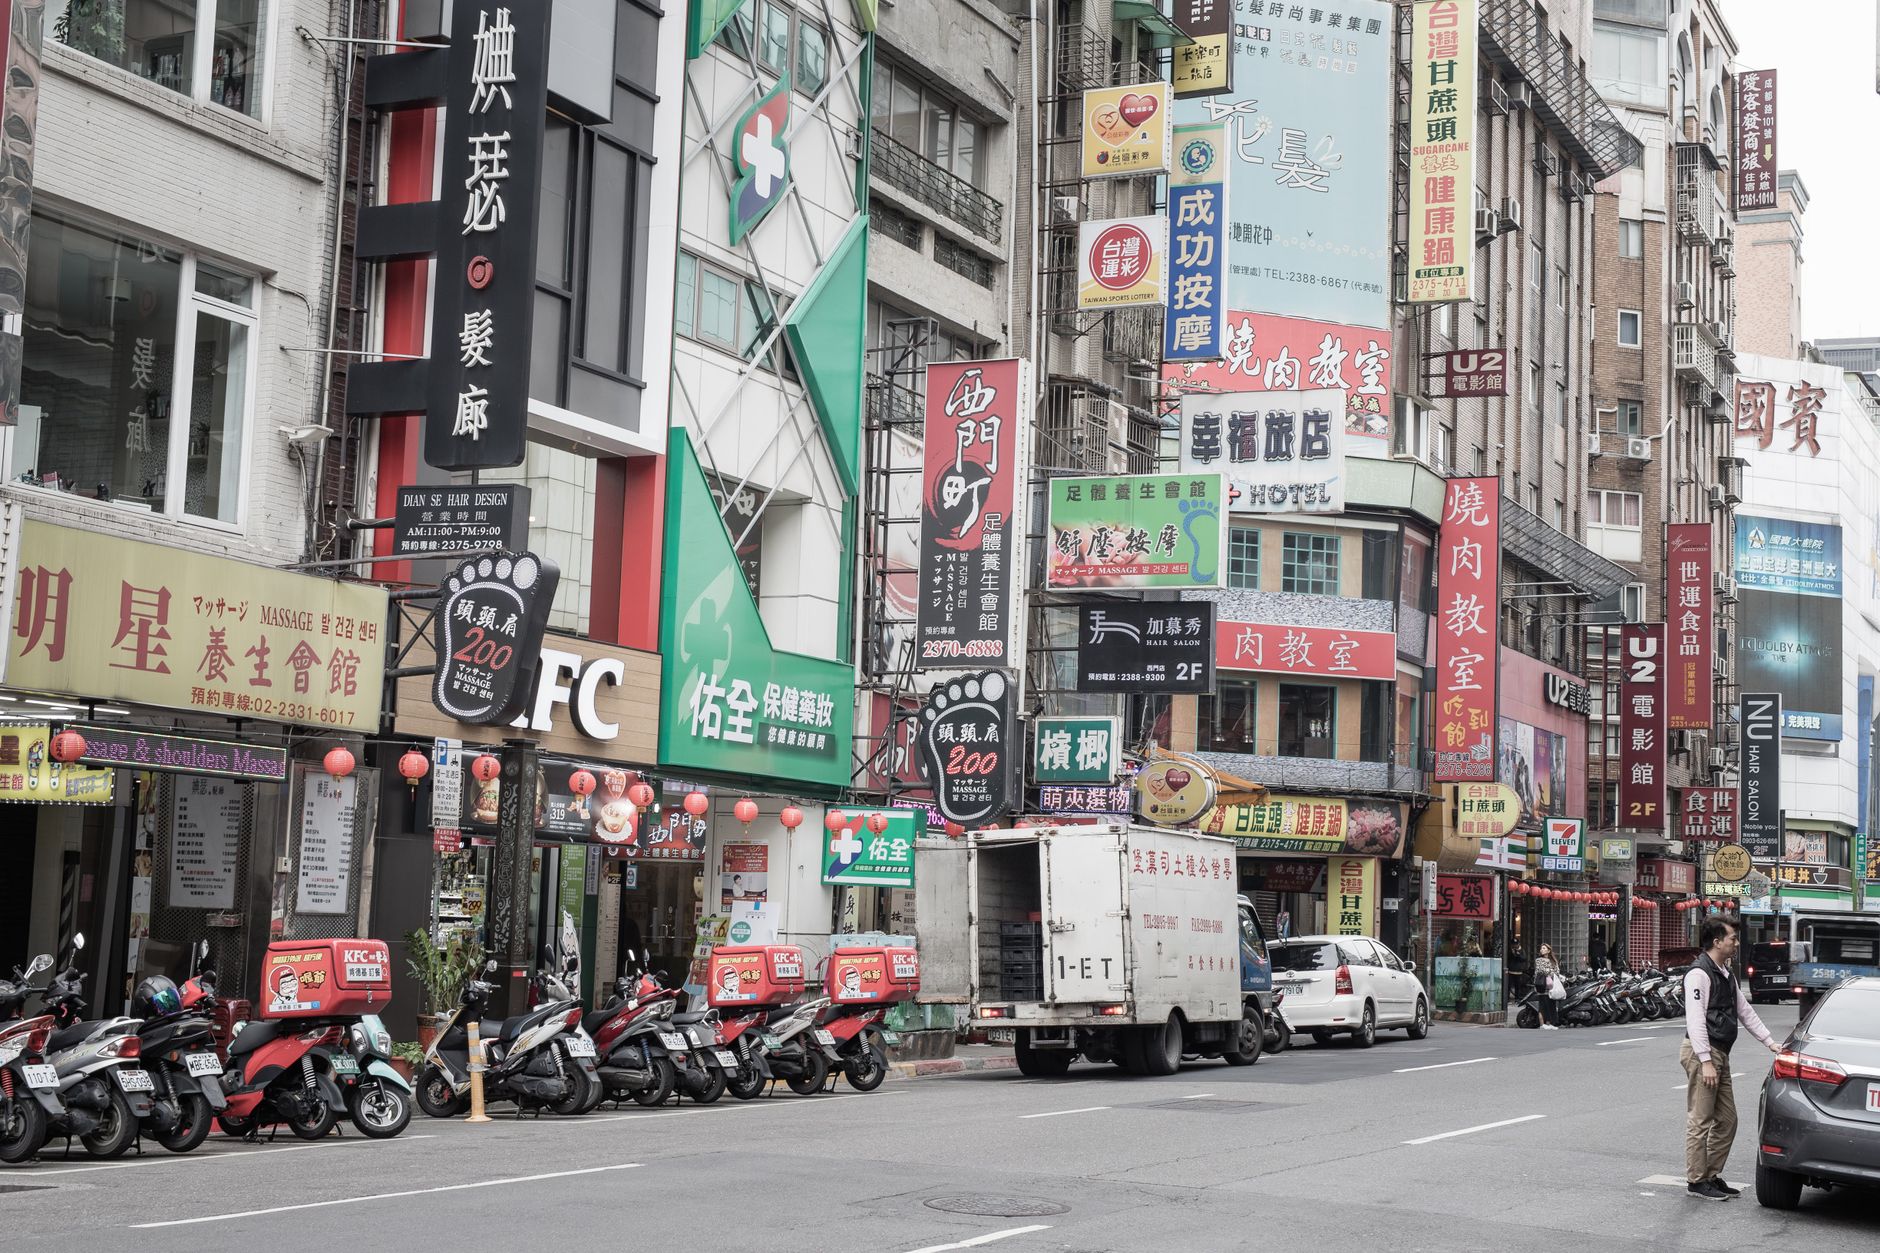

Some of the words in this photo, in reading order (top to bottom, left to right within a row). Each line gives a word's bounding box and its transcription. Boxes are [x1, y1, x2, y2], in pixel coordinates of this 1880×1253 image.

[1426, 59, 1459, 143] 甘蔗頭
[1413, 143, 1470, 156] SUGARCANE
[1423, 176, 1456, 267] 健康鍋
[1101, 237, 1140, 259] 台灣
[1100, 257, 1140, 279] 運彩
[1173, 189, 1215, 352] 成功按摩
[1264, 267, 1349, 289] TEL:2388-6867
[1412, 277, 1467, 290] 2375-4711
[1084, 295, 1108, 304] TAIWAN
[1109, 294, 1129, 302] SPORTS
[1130, 292, 1155, 301] LOTTERY
[1218, 317, 1390, 396] 燒肉教室
[1451, 353, 1503, 373] U2
[454, 308, 495, 438] 髮廊
[1451, 374, 1503, 391] 電影館
[1346, 394, 1381, 413] 餐廳
[1734, 378, 1828, 458] 國賓
[1191, 407, 1333, 464] 幸福旅店
[942, 368, 1003, 538] 西門町
[403, 493, 425, 508] DIAN
[430, 493, 442, 507] SE
[447, 492, 469, 507] HAIR
[474, 492, 508, 507] DESIGN
[1066, 480, 1207, 503] 足體養生會館
[1249, 482, 1331, 506] HOTEL
[421, 510, 488, 523] 營業時間
[978, 512, 1003, 631] 足體養生會館
[1098, 565, 1138, 575] MASSAGE
[945, 553, 957, 622] MASSAGE
[1444, 480, 1489, 692] 燒肉教室
[13, 564, 173, 675] 明星
[192, 595, 249, 623] マッサージ
[259, 604, 314, 632] MASSAGE
[321, 612, 332, 635] 발
[358, 619, 378, 644] 센터
[1678, 561, 1702, 656] 世運食品
[924, 625, 956, 636] 預約專線
[1146, 617, 1202, 636] 加慕秀
[453, 626, 514, 671] 200
[922, 640, 1004, 658] 2370-6888
[1146, 638, 1168, 647] HAIR
[1173, 638, 1202, 647] SALON
[1235, 626, 1361, 673] 肉教室
[196, 624, 362, 698] 養生會館
[458, 663, 494, 681] マッサージ
[1175, 662, 1203, 682] 2F
[1629, 637, 1657, 683] U2
[455, 671, 492, 690] MASSAGE
[509, 649, 626, 741] FC
[763, 681, 834, 728] 保健藥妝
[690, 672, 759, 744] 佑全
[1747, 700, 1774, 740] NU
[768, 726, 826, 750] 您健康的顧問
[1039, 729, 1110, 772] 檳榔
[1631, 695, 1655, 785] 電影館
[133, 738, 150, 762] &
[154, 741, 229, 770] shoulders
[437, 740, 448, 765] P
[946, 745, 998, 775] 200
[1748, 745, 1760, 774] HAIR
[1436, 763, 1492, 777] 2375-5286
[1461, 799, 1506, 813] 甘蔗頭
[1629, 802, 1657, 816] 2F
[1748, 778, 1760, 822] SALON
[1295, 803, 1342, 837] 健康鍋
[1685, 790, 1708, 836] 食品
[868, 837, 911, 862] 佑全
[1260, 838, 1303, 850] 2375-4711
[343, 950, 369, 963] KFC
[773, 952, 790, 963] KFC
[892, 954, 907, 965] KFC
[349, 967, 367, 977] 肯德基
[368, 967, 381, 977] 訂餐
[1693, 988, 1701, 1001] 3
